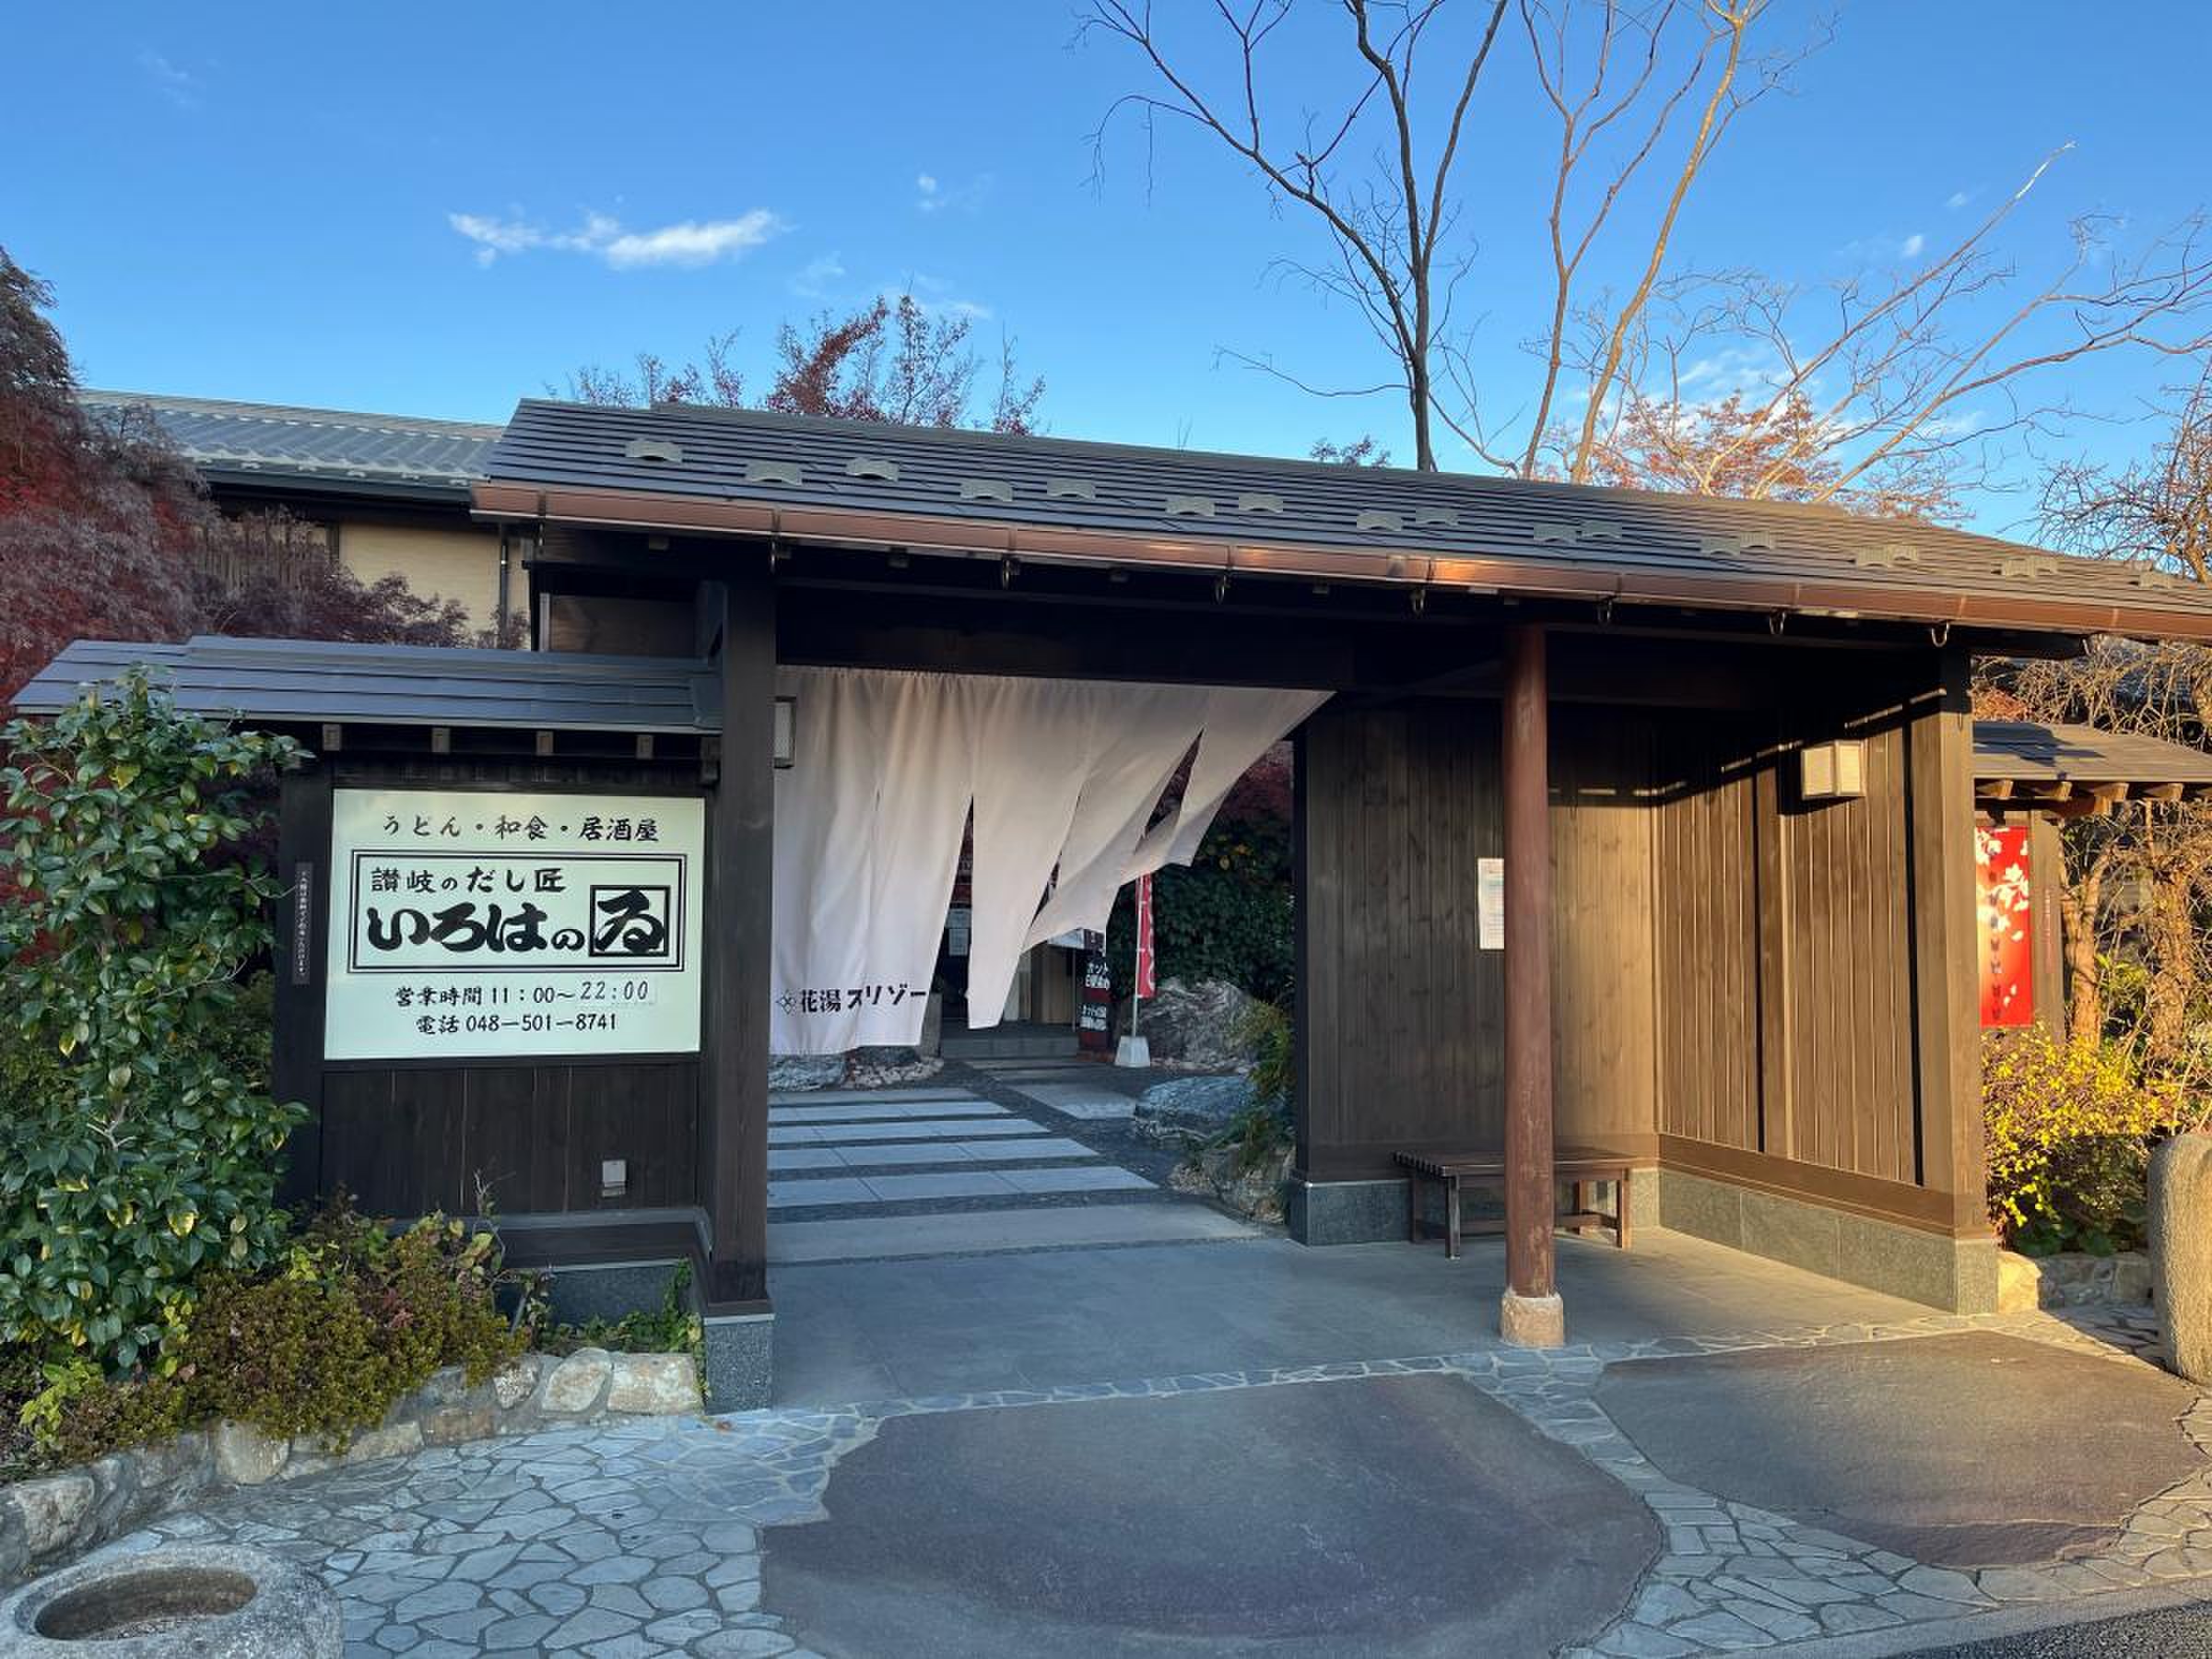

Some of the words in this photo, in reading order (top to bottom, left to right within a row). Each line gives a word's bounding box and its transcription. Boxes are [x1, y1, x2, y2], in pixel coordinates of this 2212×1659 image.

[382, 815, 660, 841] うどん・和食・居酒屋
[371, 866, 567, 893] 讃岐のだし匠
